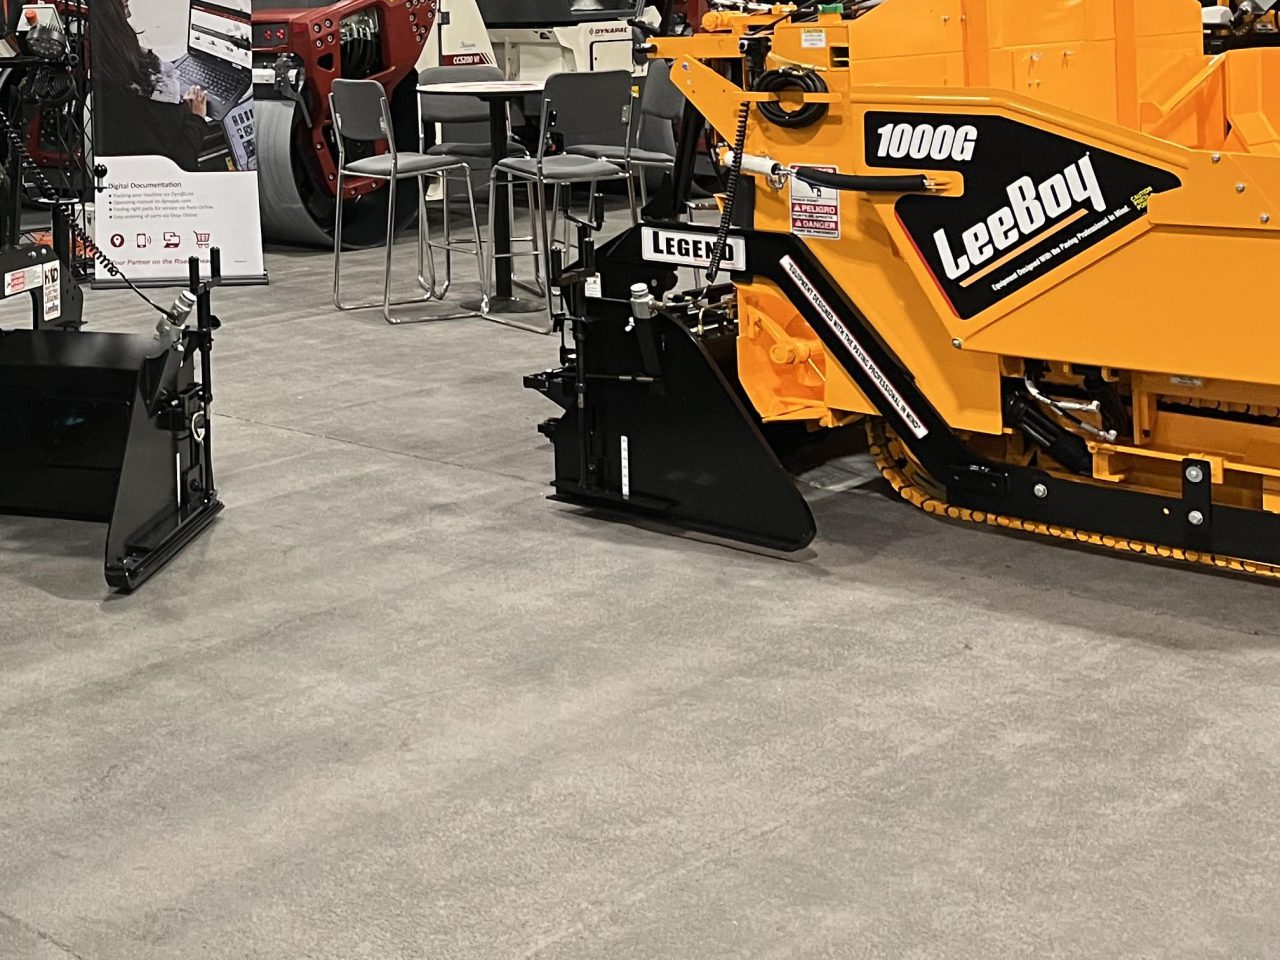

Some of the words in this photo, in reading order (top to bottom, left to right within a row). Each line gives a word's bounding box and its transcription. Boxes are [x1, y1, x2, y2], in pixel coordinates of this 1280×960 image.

[876, 123, 978, 161] 1000G
[108, 182, 129, 190] Digital
[130, 181, 182, 189] Documentation
[801, 204, 836, 214] PELIGRO
[932, 154, 1107, 280] LeeBoy
[803, 220, 836, 230] DANGER
